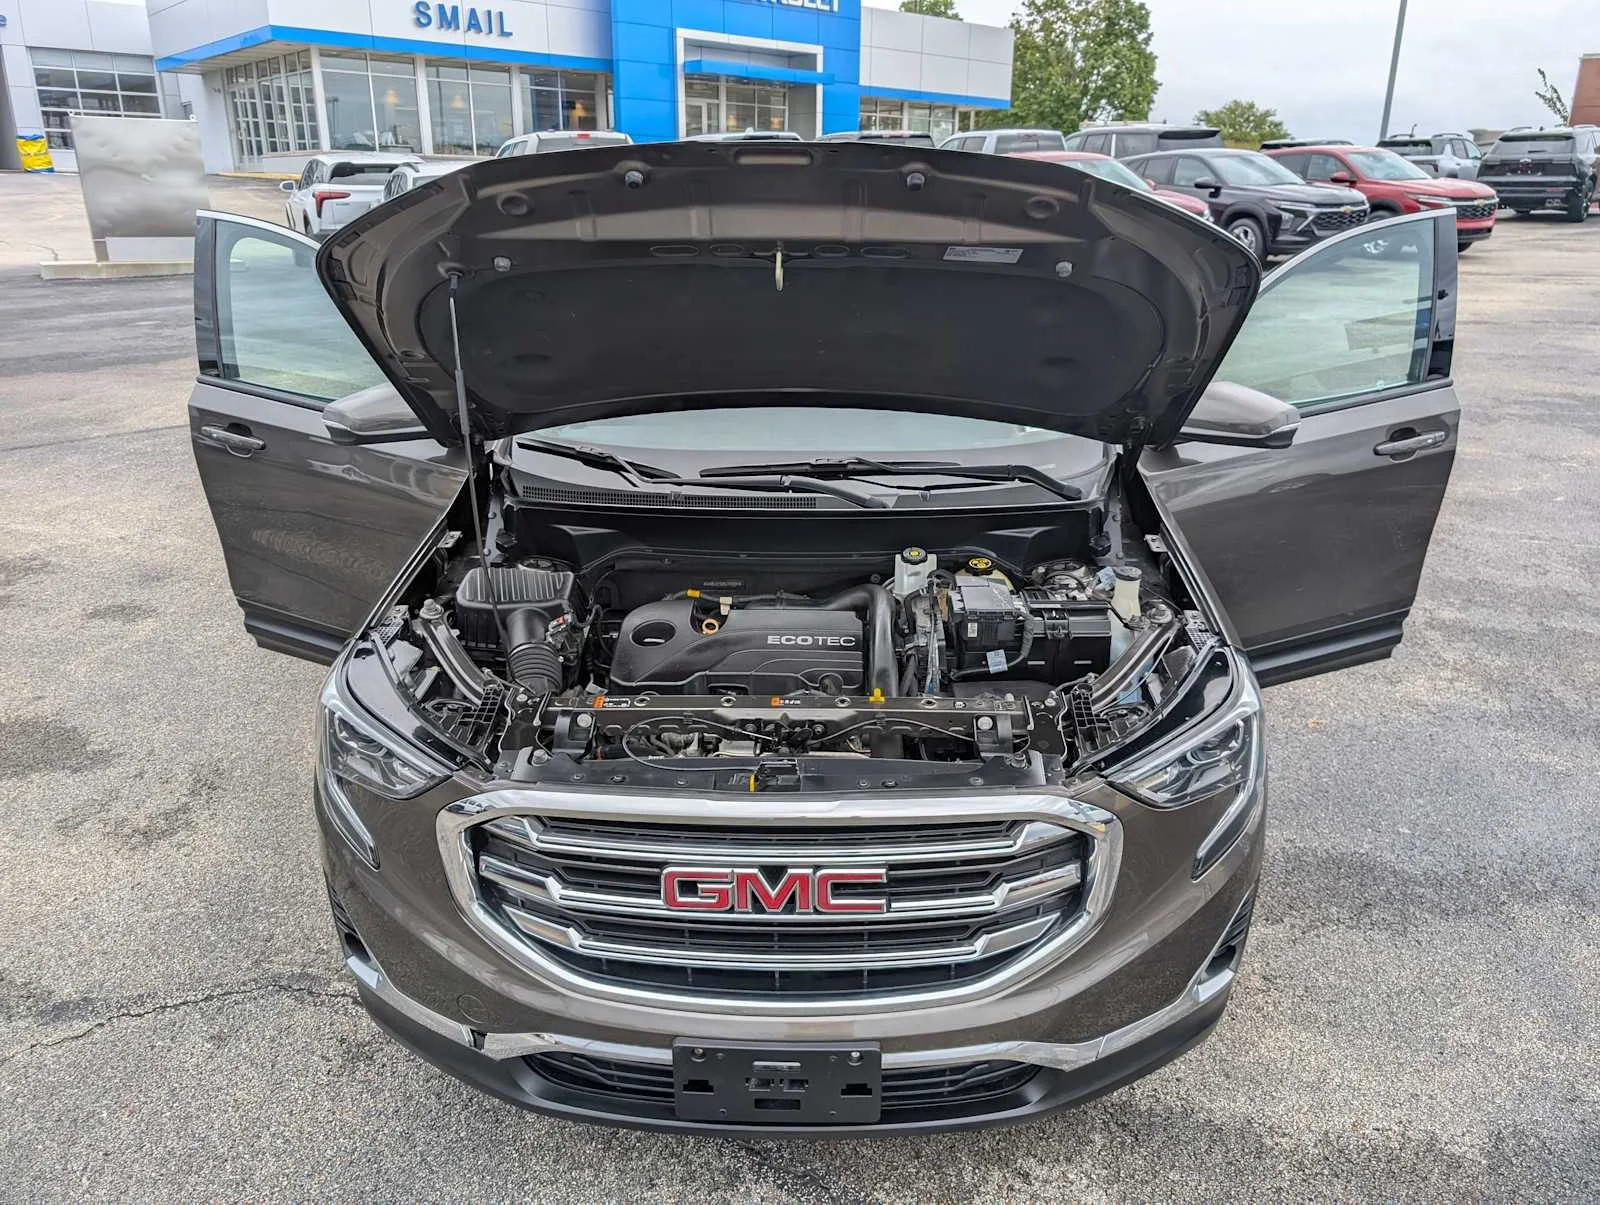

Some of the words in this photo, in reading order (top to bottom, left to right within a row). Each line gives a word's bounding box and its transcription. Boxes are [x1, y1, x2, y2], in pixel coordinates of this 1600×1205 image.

[414, 1, 513, 36] SMAIL
[767, 635, 856, 647] ECOTEC
[661, 866, 888, 913] GMC
